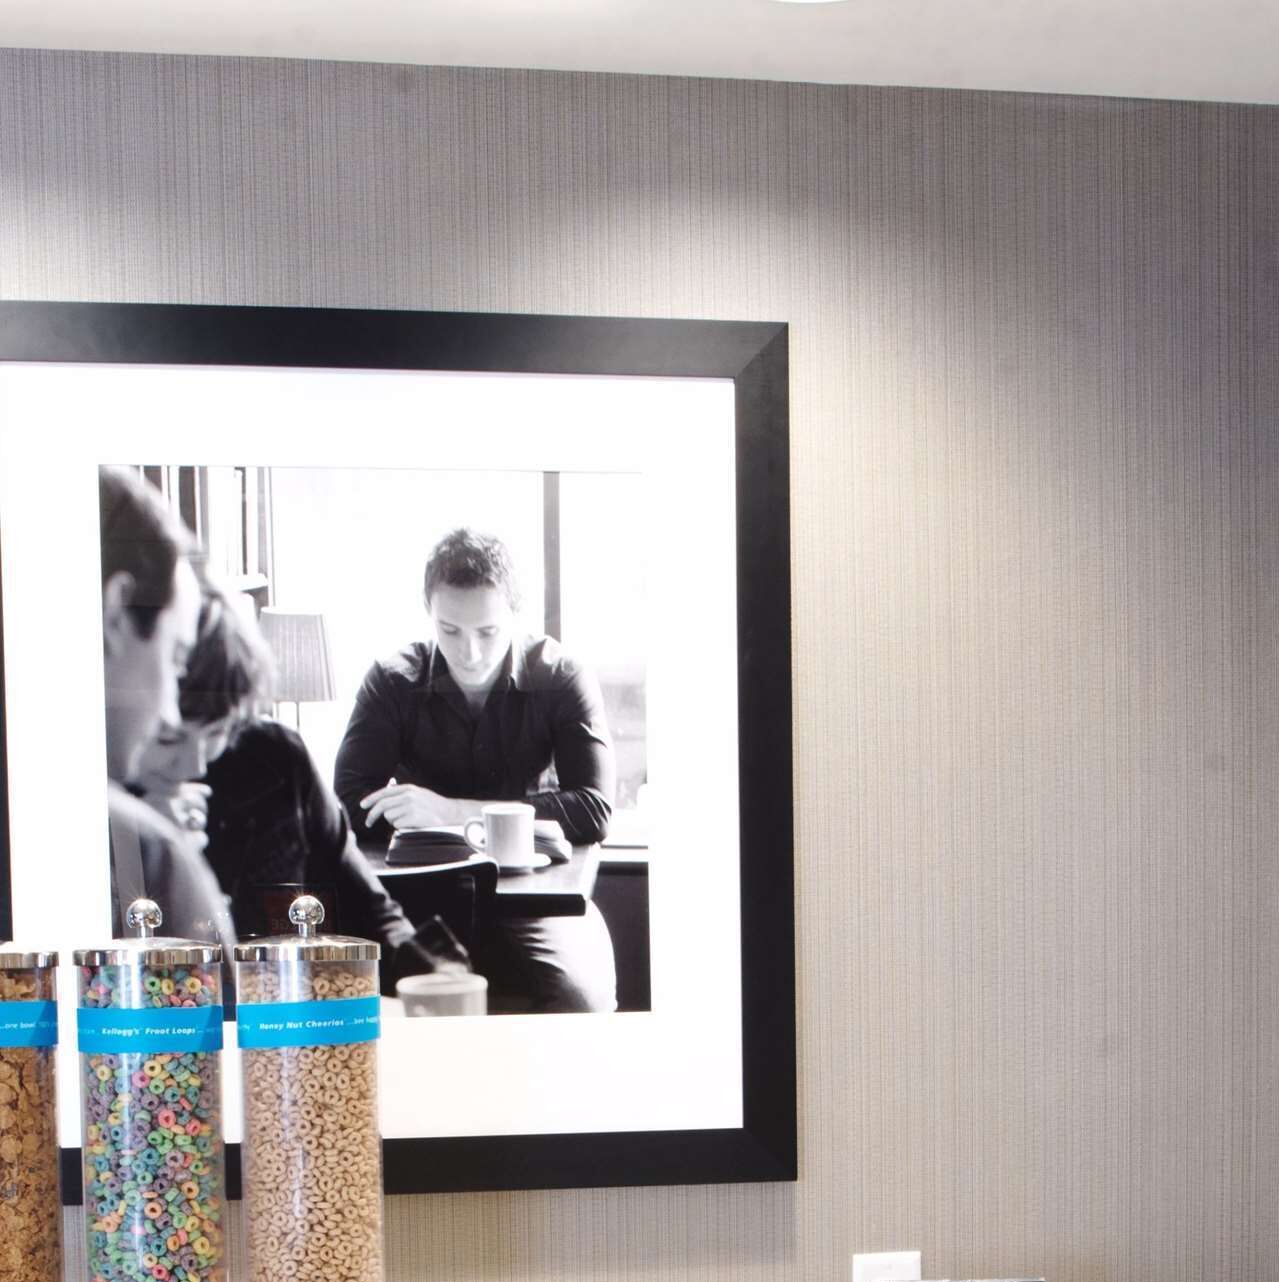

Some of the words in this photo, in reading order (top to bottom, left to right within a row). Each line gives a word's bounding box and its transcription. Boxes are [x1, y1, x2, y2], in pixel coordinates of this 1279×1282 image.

[259, 1022, 284, 1032] Honey
[286, 1021, 303, 1030] Nut
[305, 1019, 345, 1029] Cheerios
[101, 1027, 140, 1037] Kellogg's
[144, 1027, 170, 1036] Froot
